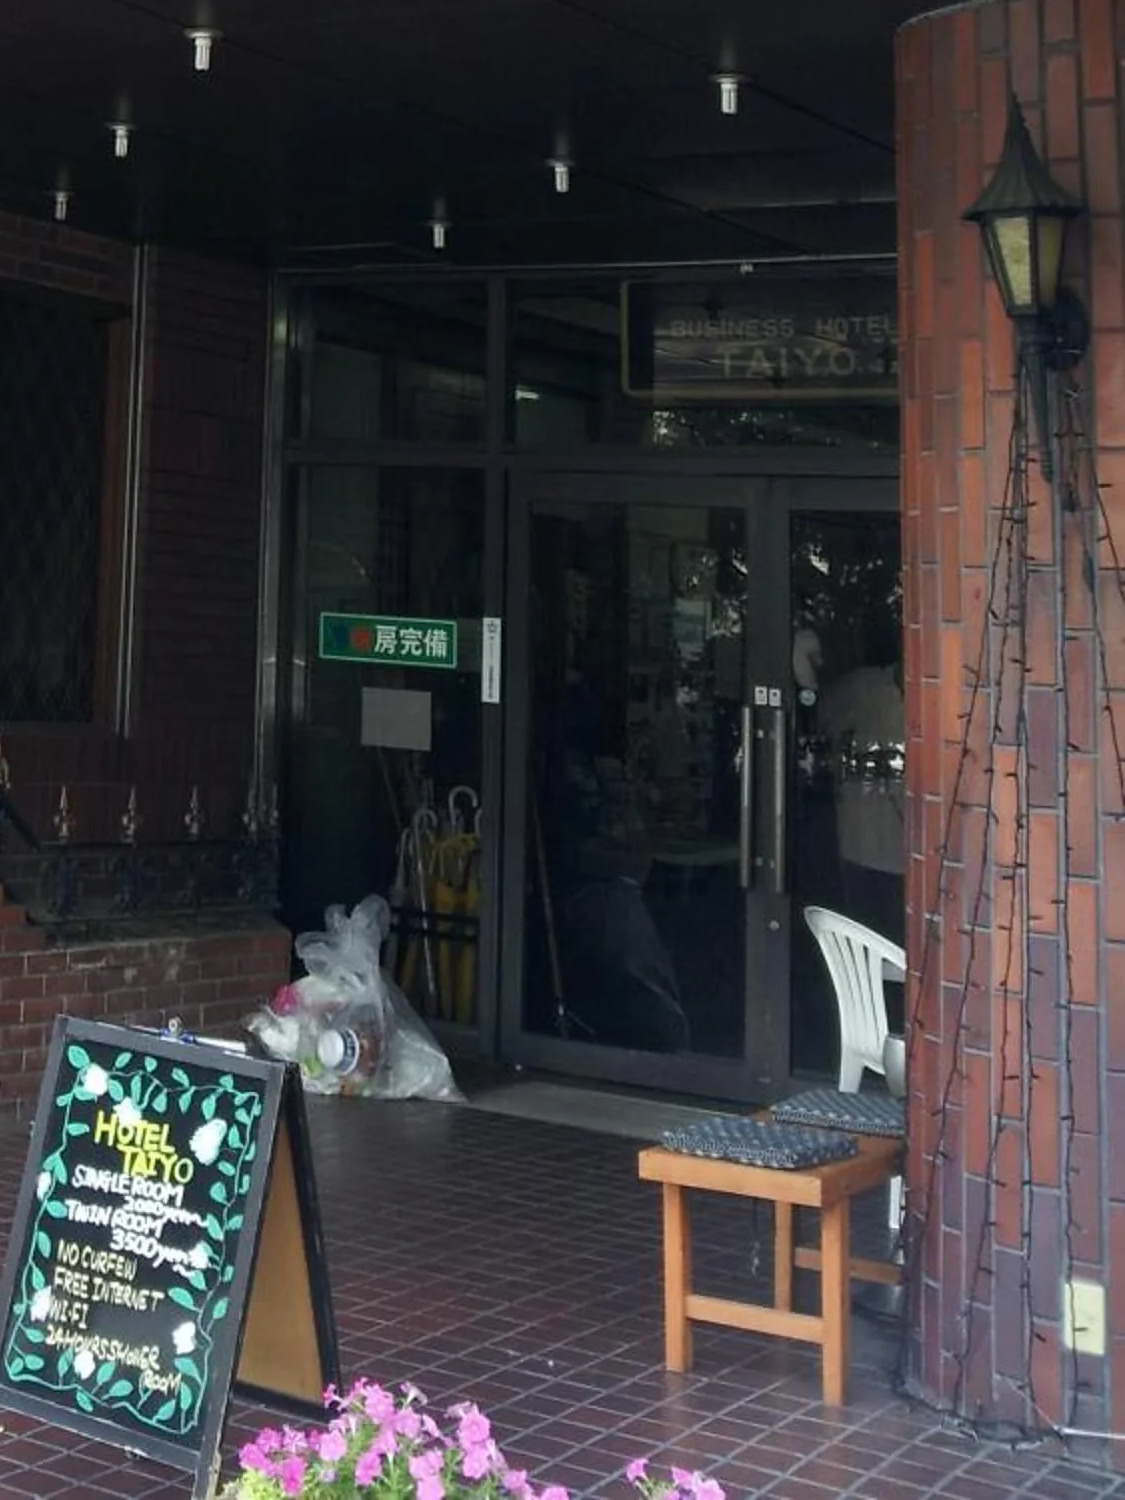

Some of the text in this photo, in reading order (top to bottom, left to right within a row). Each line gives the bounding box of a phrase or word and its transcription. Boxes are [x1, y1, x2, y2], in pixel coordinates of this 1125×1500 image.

[671, 314, 898, 339] BUSINESS HOTEL
[722, 345, 856, 378] TAIYO
[330, 622, 449, 659] 房完備
[94, 1110, 175, 1154] HOTEL
[116, 1144, 195, 1183] TAIYO
[72, 1164, 185, 1207] SINGLE ROOM
[64, 1199, 164, 1238] TWIN ROOM
[57, 1239, 138, 1281] NO CURFEW
[54, 1266, 166, 1312] FREE INTERNET
